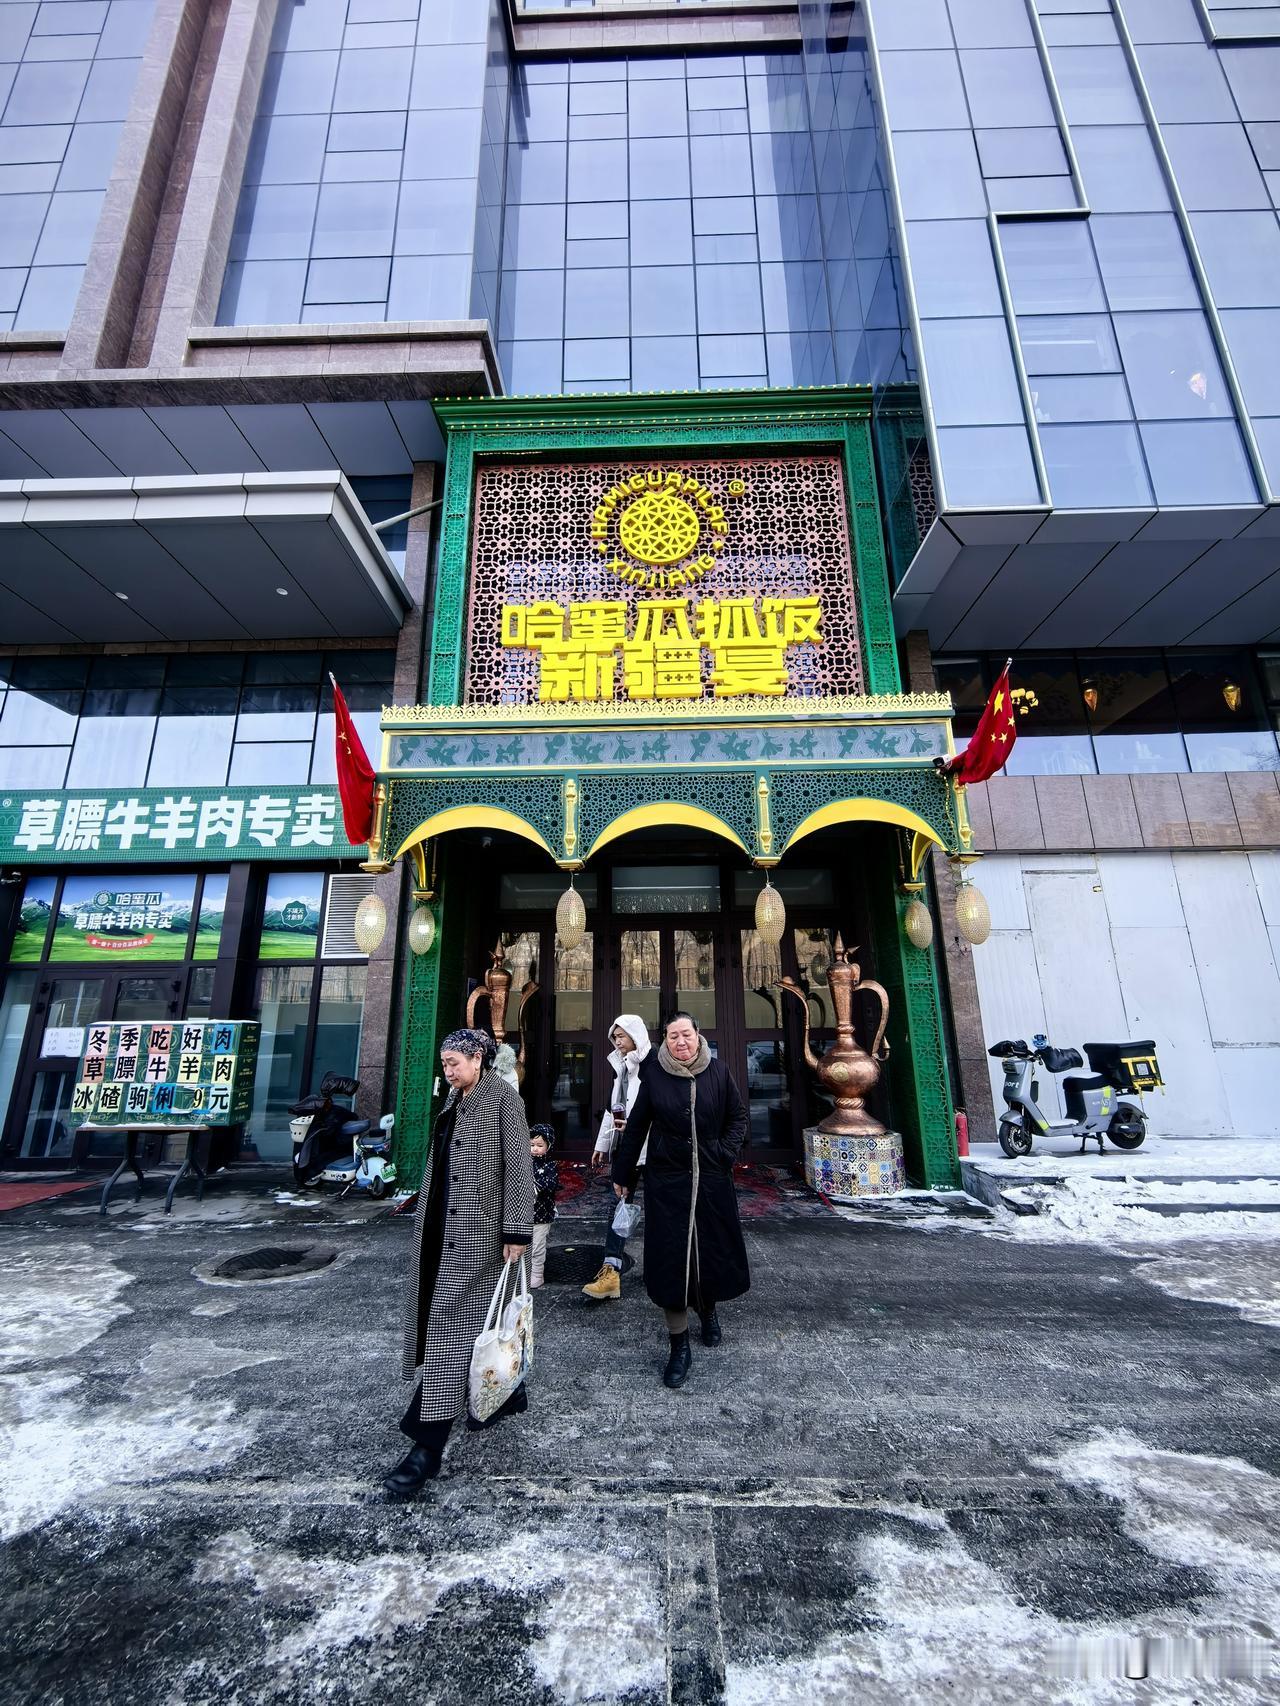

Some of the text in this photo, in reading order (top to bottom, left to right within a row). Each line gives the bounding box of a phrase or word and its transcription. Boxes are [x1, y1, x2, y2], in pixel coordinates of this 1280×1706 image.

[605, 553, 716, 590] XINJIANG
[538, 641, 790, 700] 新疆宴
[13, 793, 337, 851] 草膘牛羊肉专卖
[74, 911, 173, 930] 草膘牛羊肉专卖
[89, 1027, 232, 1053] 冬季吃好肉
[84, 1055, 233, 1081] 草膘牛羊肉
